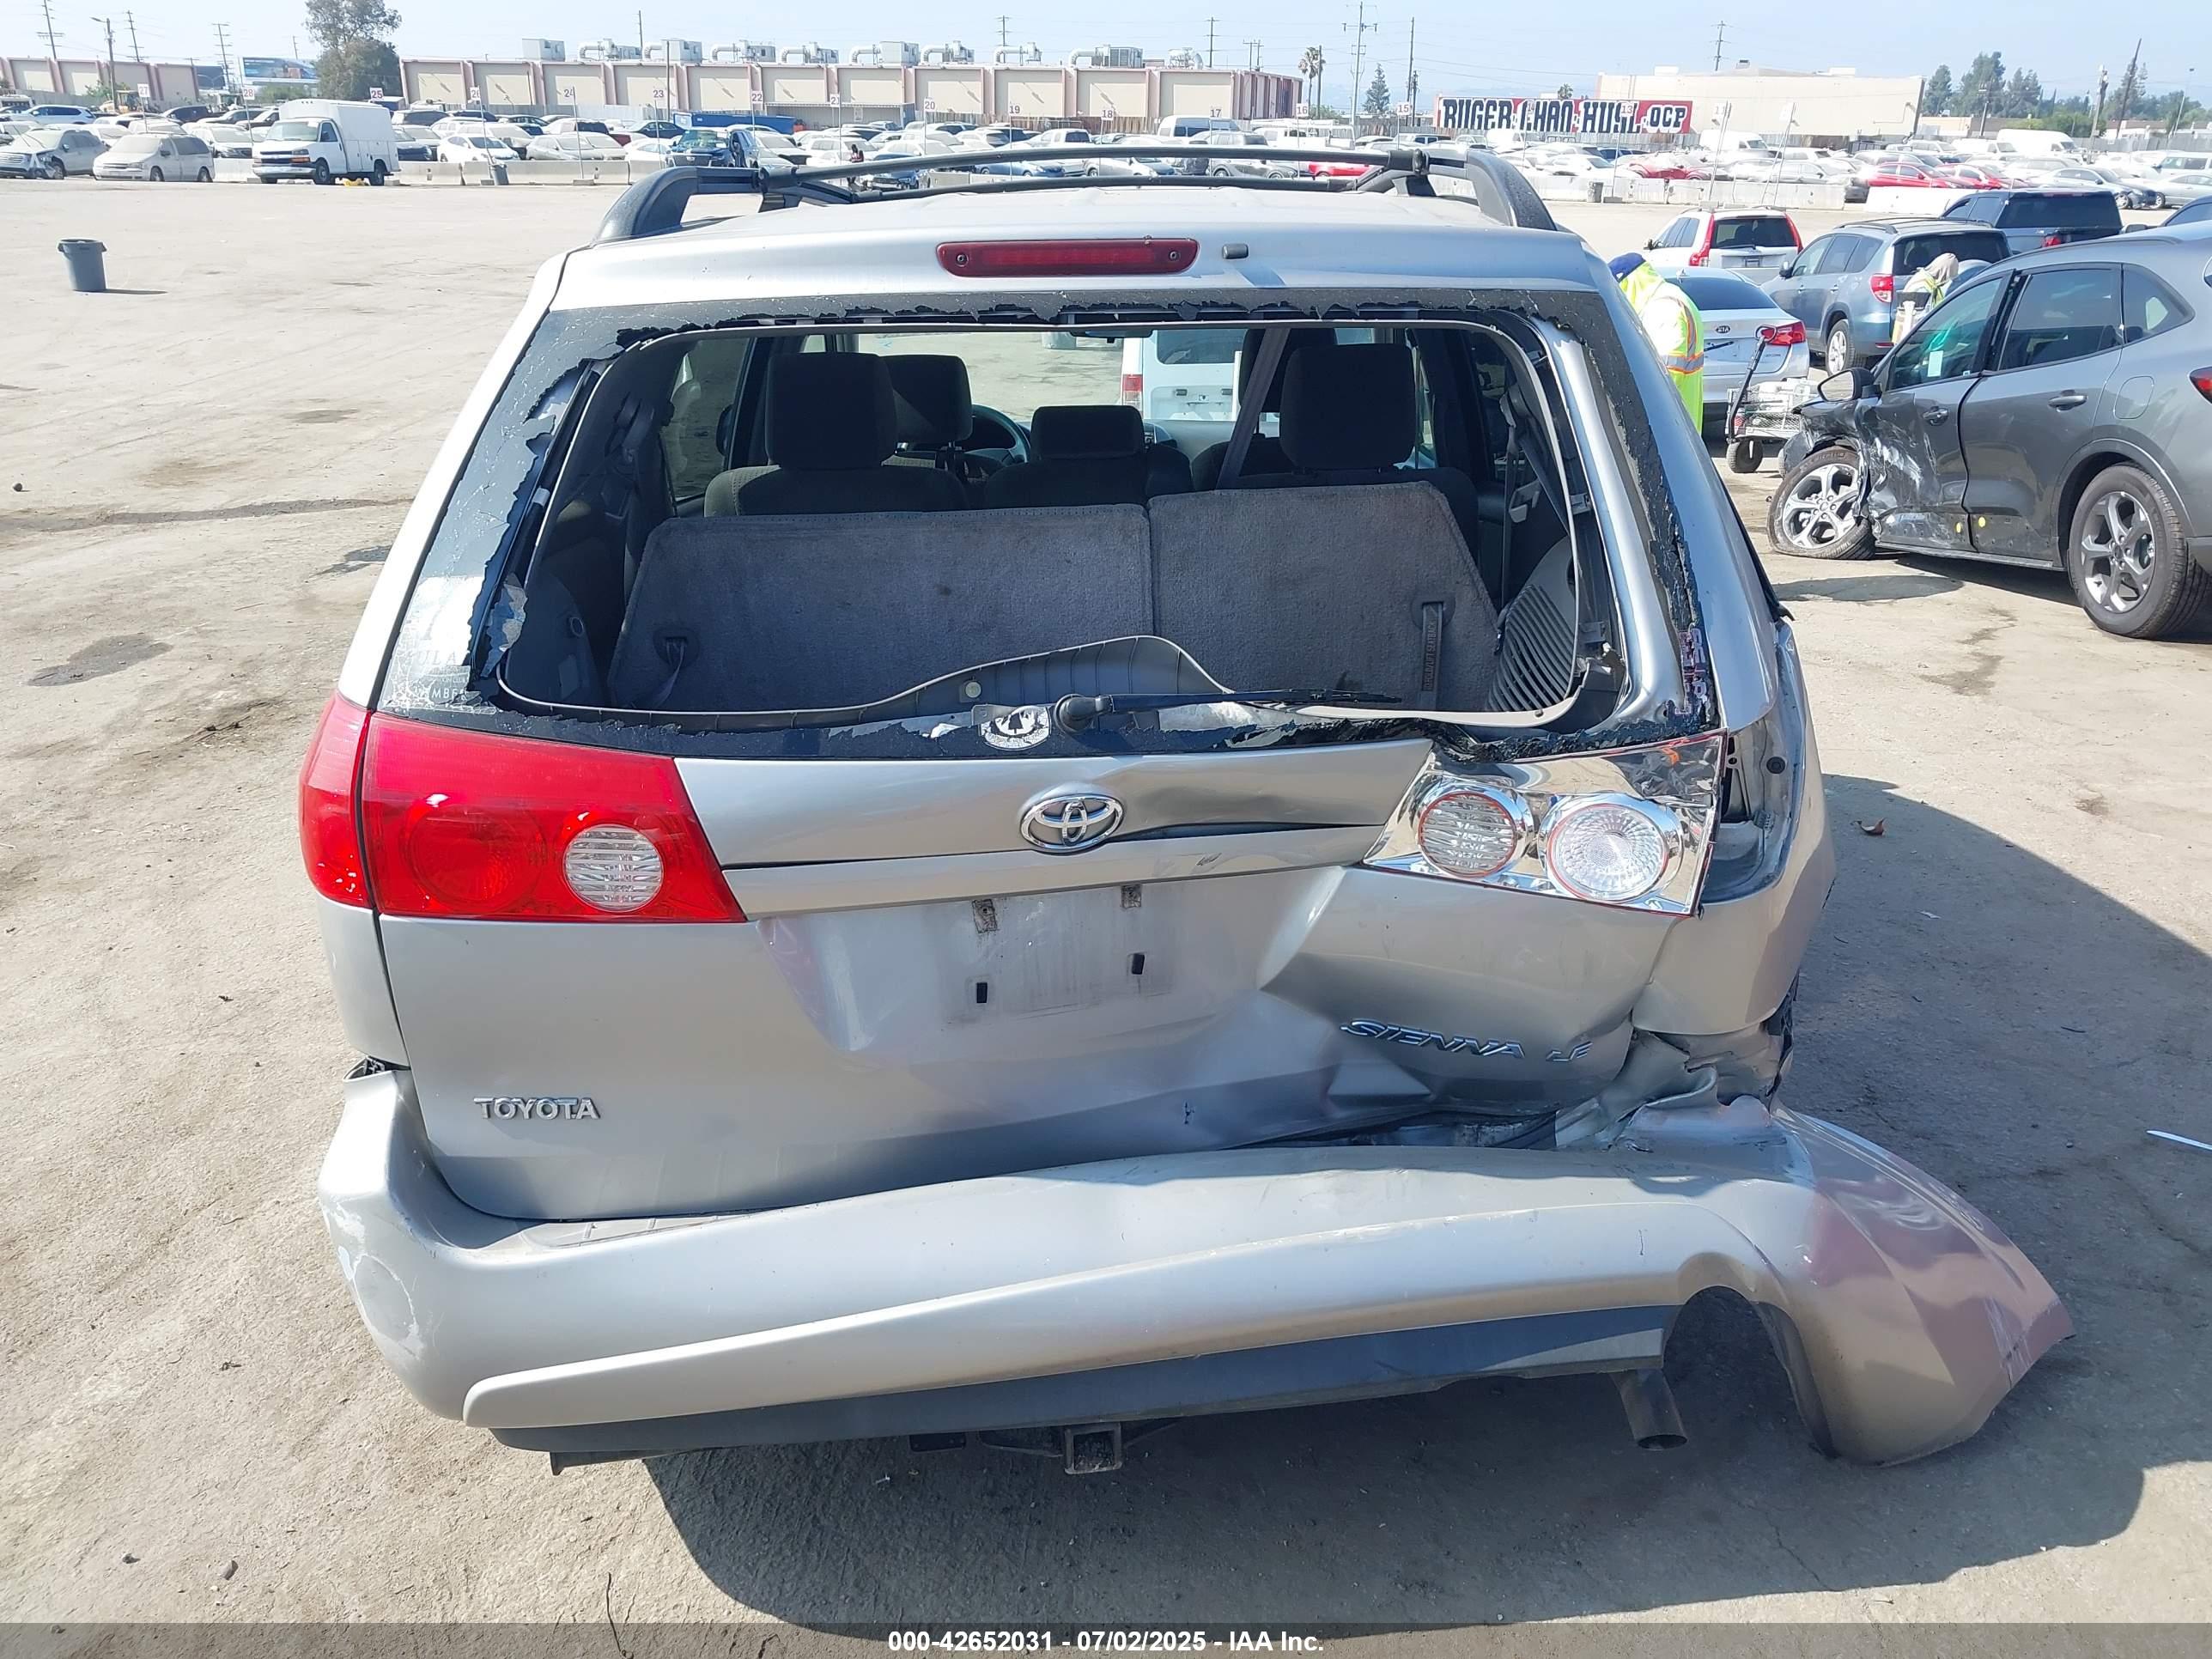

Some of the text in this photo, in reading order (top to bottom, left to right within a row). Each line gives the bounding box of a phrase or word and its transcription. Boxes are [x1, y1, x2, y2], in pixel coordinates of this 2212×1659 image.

[139, 87, 148, 95] 27
[371, 90, 383, 99] 25
[653, 89, 664, 98] 23
[751, 93, 763, 101] 22
[925, 101, 935, 110] 20
[1297, 106, 1307, 114] 16
[1398, 104, 1409, 112] 15
[1621, 105, 1633, 113] 13
[1211, 109, 1221, 118] 17
[1716, 325, 1731, 334] KIA
[1340, 1018, 1525, 1058] SIENNA
[473, 1097, 600, 1120] TOYOTA
